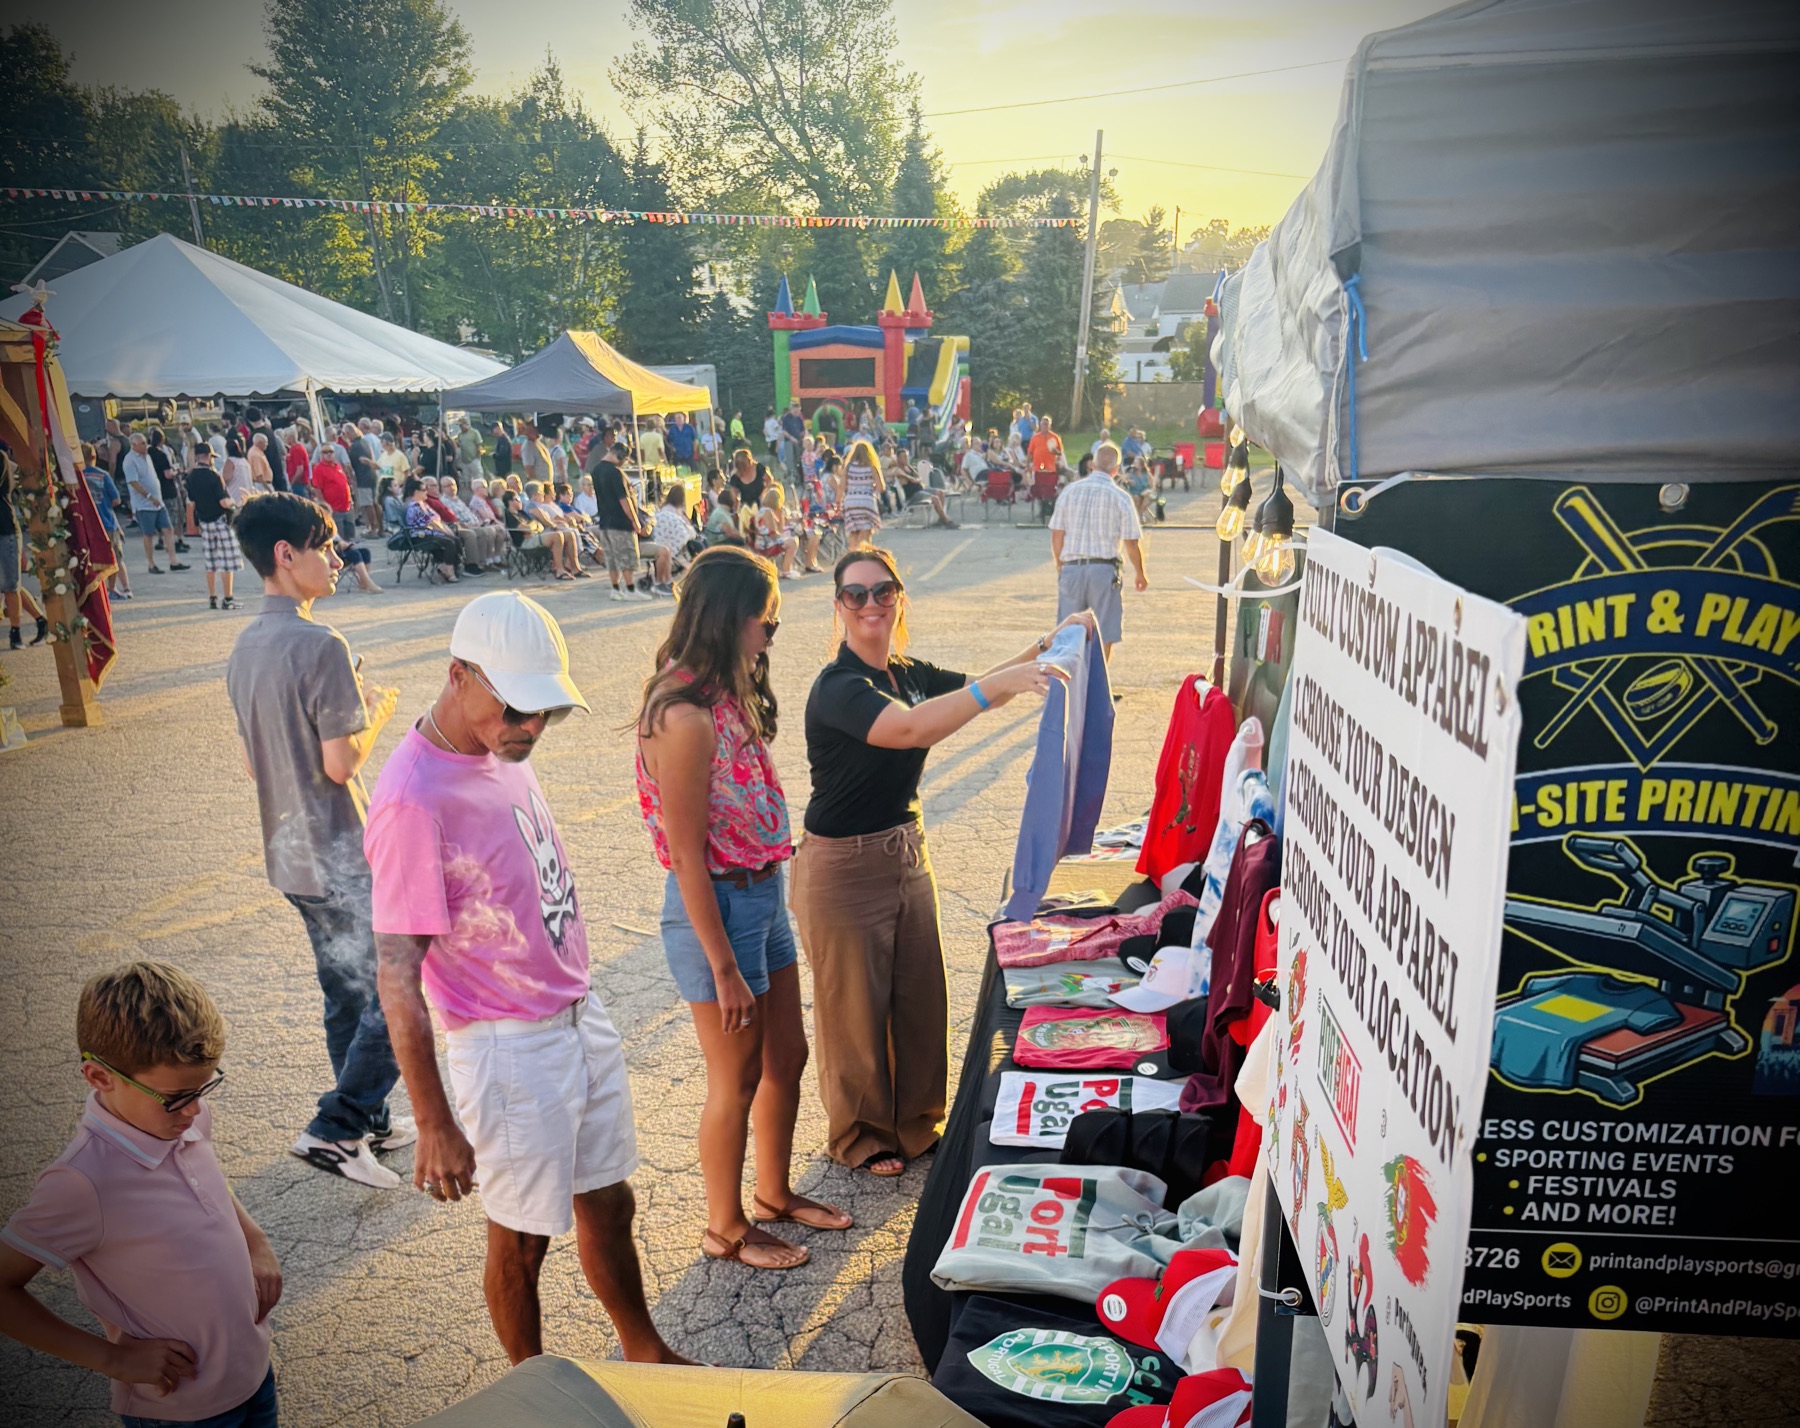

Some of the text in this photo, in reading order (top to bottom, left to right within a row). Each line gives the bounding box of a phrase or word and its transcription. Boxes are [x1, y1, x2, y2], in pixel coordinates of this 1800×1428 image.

[1527, 589, 1800, 658] RINT & PLAY
[1303, 558, 1339, 643] FULLY
[1339, 578, 1400, 690] CUSTOM
[1399, 612, 1490, 762] APPAREL
[1345, 714, 1383, 821] YOUR
[1384, 754, 1455, 899] DESIGN
[1510, 779, 1628, 833] -SITE
[1338, 810, 1375, 924] YOUR
[1375, 864, 1458, 1045] APPAREL
[1331, 902, 1367, 1022] YOUR
[1367, 963, 1459, 1175] LOCATION
[1318, 1004, 1360, 1146] PORTUGAL
[1476, 1119, 1800, 1148] ESS CUSTOMIZATION F
[1494, 1149, 1735, 1174] SPORTING EVENTS
[1527, 1175, 1678, 1199] FESTIVALS
[1023, 1177, 1082, 1257] Port
[1521, 1201, 1677, 1226] AND MORE!
[1589, 1252, 1800, 1280] printandplaysports@g
[1463, 1288, 1571, 1311] dPlaySports
[1635, 1296, 1800, 1320] @PrintAndPlaySp
[987, 1333, 1026, 1381] PORTUGAL
